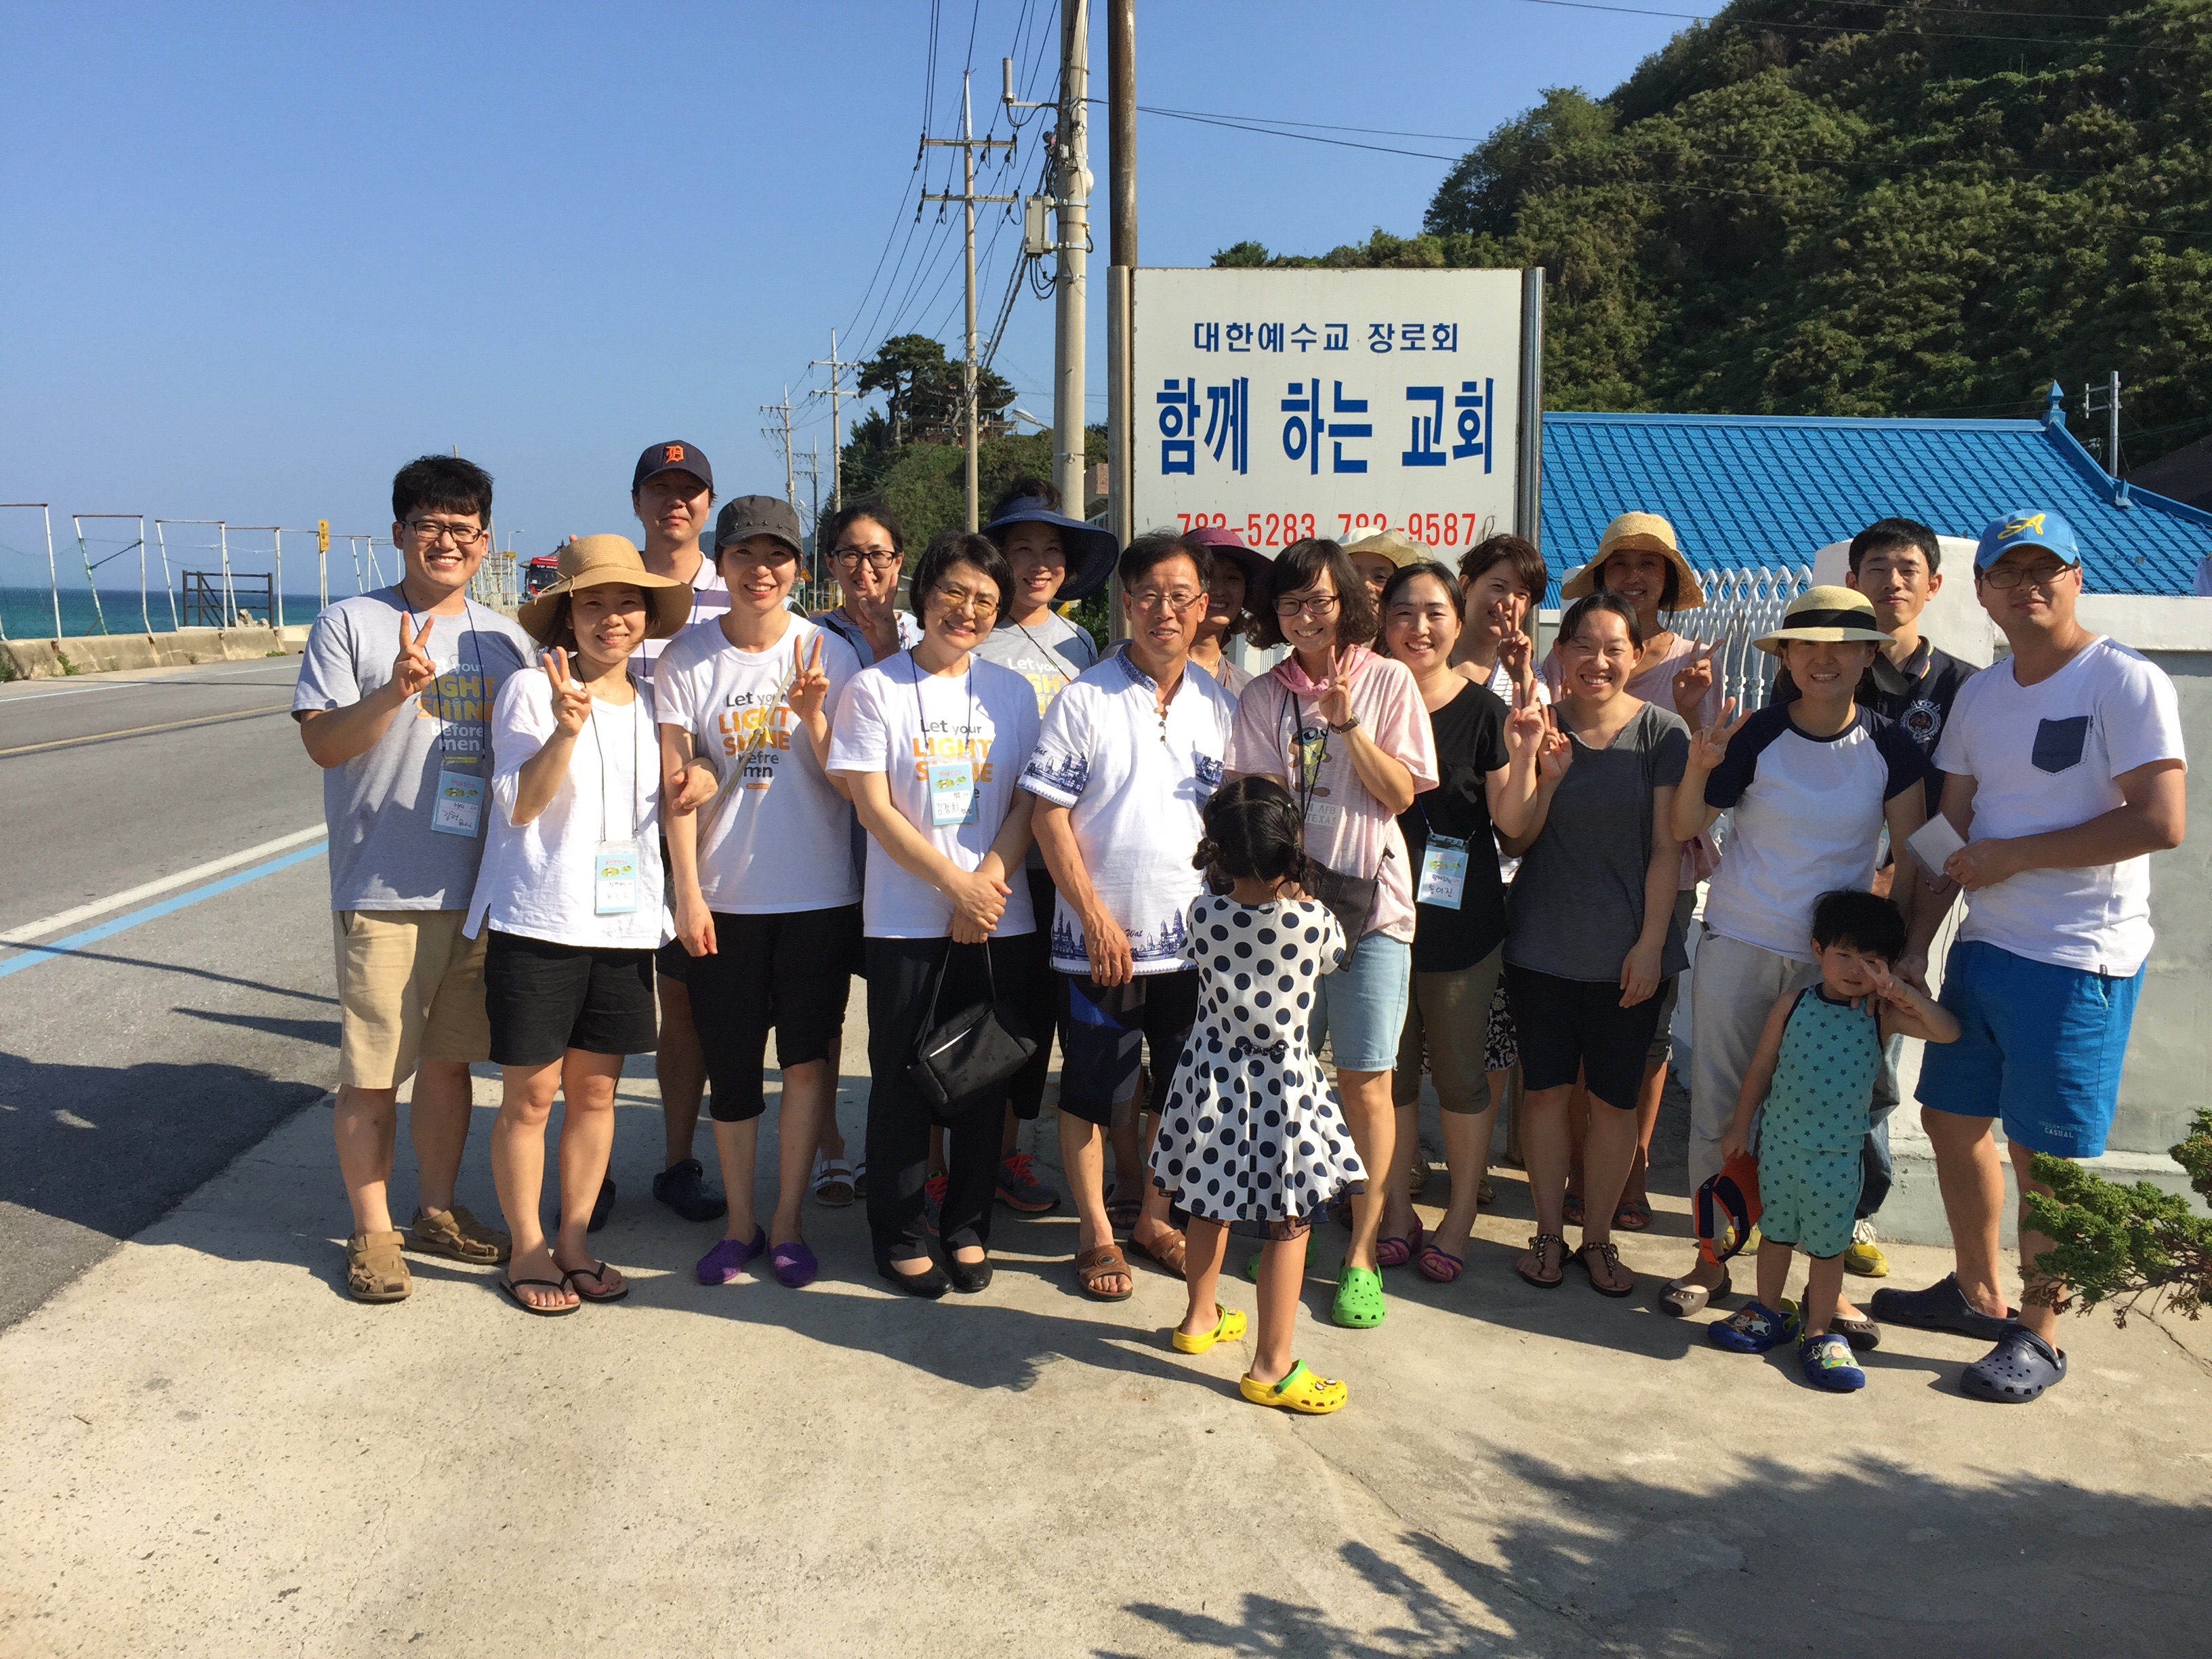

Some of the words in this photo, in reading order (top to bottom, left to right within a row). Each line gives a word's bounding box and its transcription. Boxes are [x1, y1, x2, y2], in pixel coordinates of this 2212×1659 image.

[1193, 322, 1349, 353] 대한예수교
[1368, 322, 1459, 354] 장로회
[1156, 376, 1249, 476] 함께
[1281, 377, 1373, 476] 하는
[1401, 377, 1494, 475] 교회
[1007, 657, 1035, 670] Let
[726, 691, 754, 708] Let
[757, 693, 787, 705] yor
[431, 721, 484, 737] before
[920, 720, 949, 733] Let
[951, 725, 982, 736] your
[438, 739, 480, 752] men
[912, 737, 994, 759] LIGHT
[1318, 804, 1336, 815] AFB
[1307, 813, 1337, 825] TEXAS
[2044, 1127, 2074, 1139] CASUAL
